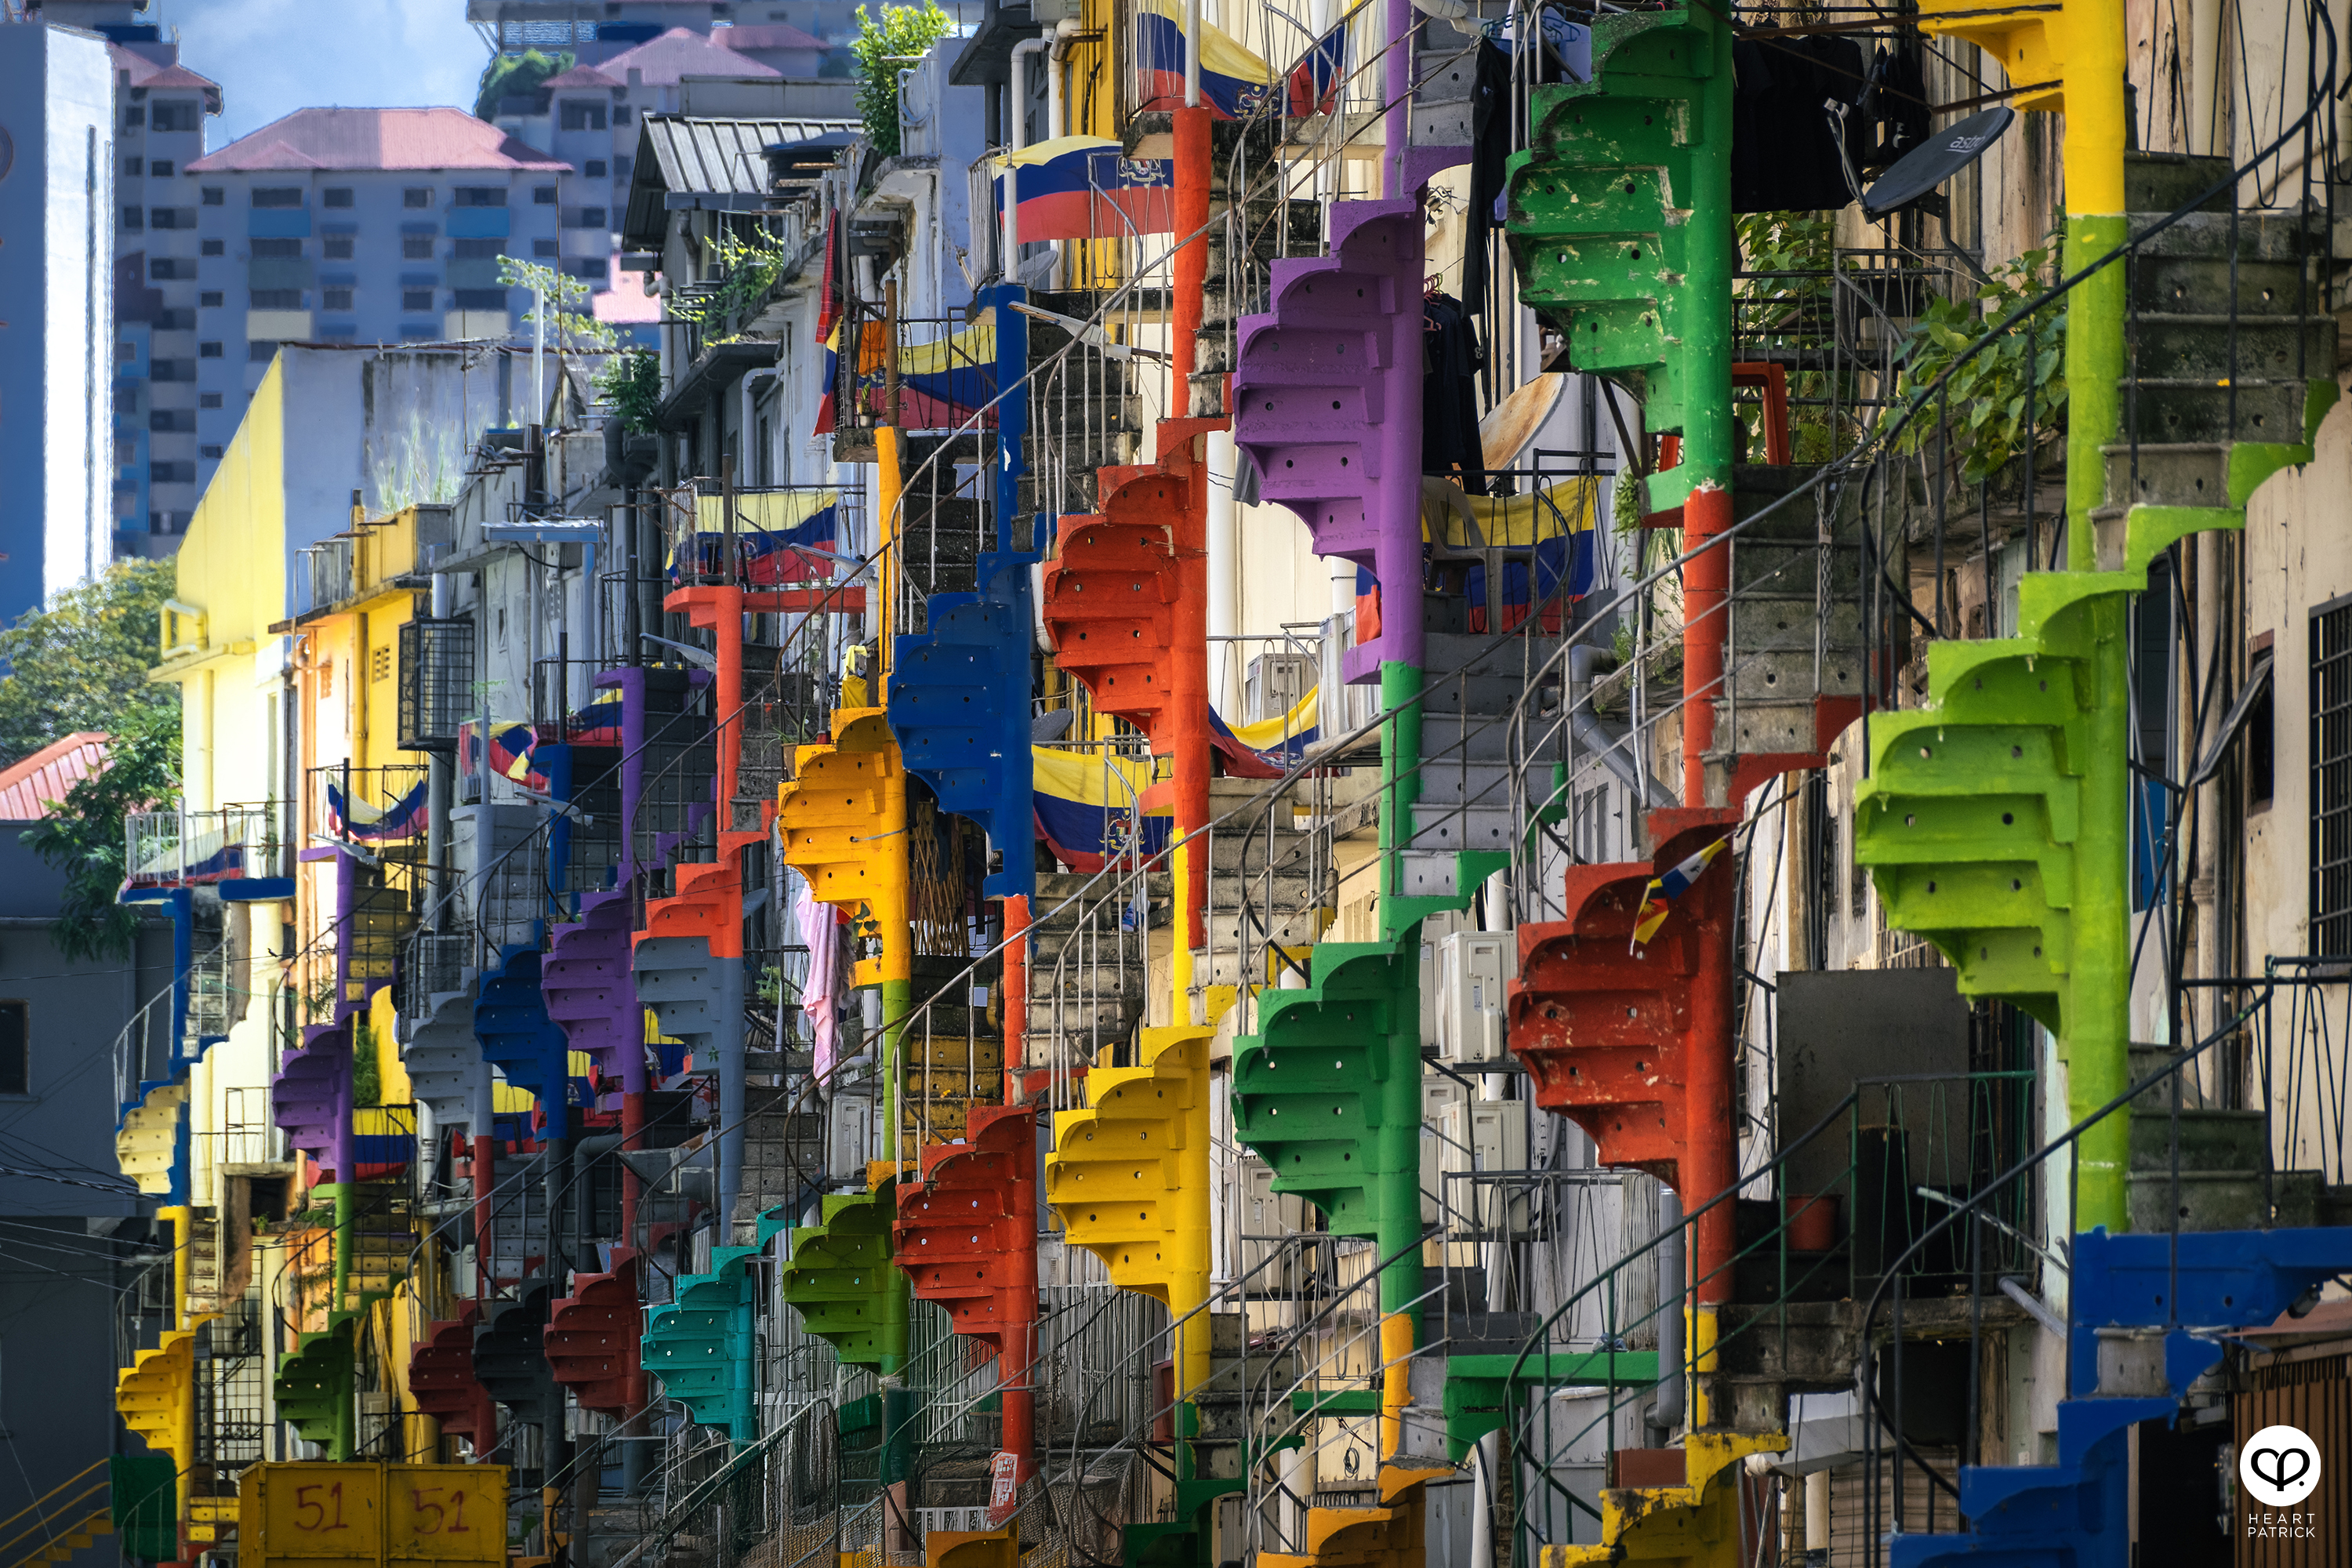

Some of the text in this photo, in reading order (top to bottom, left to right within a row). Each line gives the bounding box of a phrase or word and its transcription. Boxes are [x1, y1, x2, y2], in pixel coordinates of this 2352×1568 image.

[1949, 135, 1986, 149] astro
[293, 1480, 350, 1534] 51
[412, 1486, 470, 1535] 51
